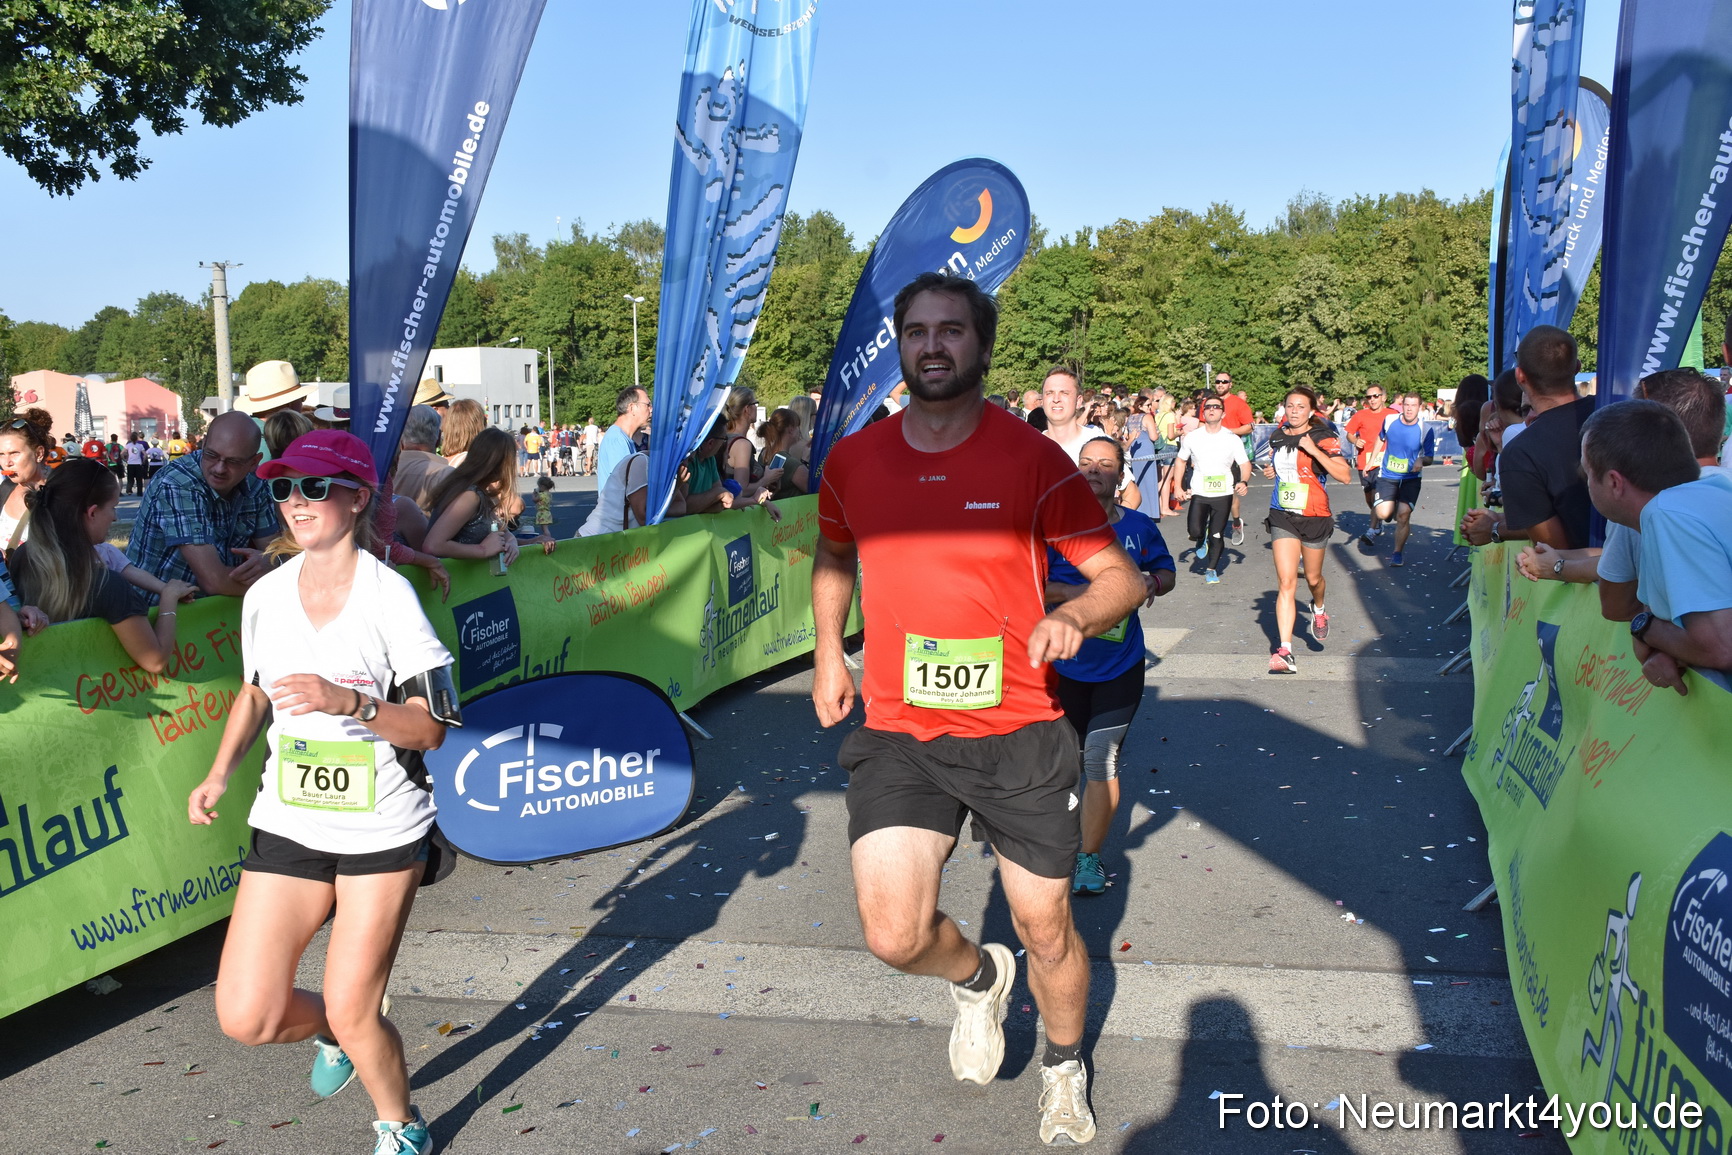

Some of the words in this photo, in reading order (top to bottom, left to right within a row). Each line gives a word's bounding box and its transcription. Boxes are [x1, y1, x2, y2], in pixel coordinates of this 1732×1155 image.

[1576, 187, 1595, 220] und
[975, 228, 1017, 272] Medien
[374, 100, 490, 433] www.fischer-automobile.de
[964, 501, 1000, 509] Johannes
[1283, 490, 1296, 501] 39
[554, 555, 607, 603] Gesunde
[610, 546, 650, 578] Firmen
[586, 590, 627, 627] laufen
[625, 563, 671, 608] länger!
[714, 572, 780, 651] firmenlauf
[471, 617, 510, 644] Fischer
[475, 631, 509, 652] AUTOMOBILE
[717, 632, 747, 660] neumarkt
[916, 662, 990, 690] 1507
[909, 686, 958, 698] Grabenbauer
[960, 688, 995, 698] Johannes
[296, 763, 350, 793] 760
[500, 748, 661, 799] Fischer
[302, 789, 323, 799] Bauer
[325, 792, 346, 800] Laura
[519, 781, 655, 818] AUTOMOBILE
[1682, 945, 1731, 998] AUTOMOBILE
